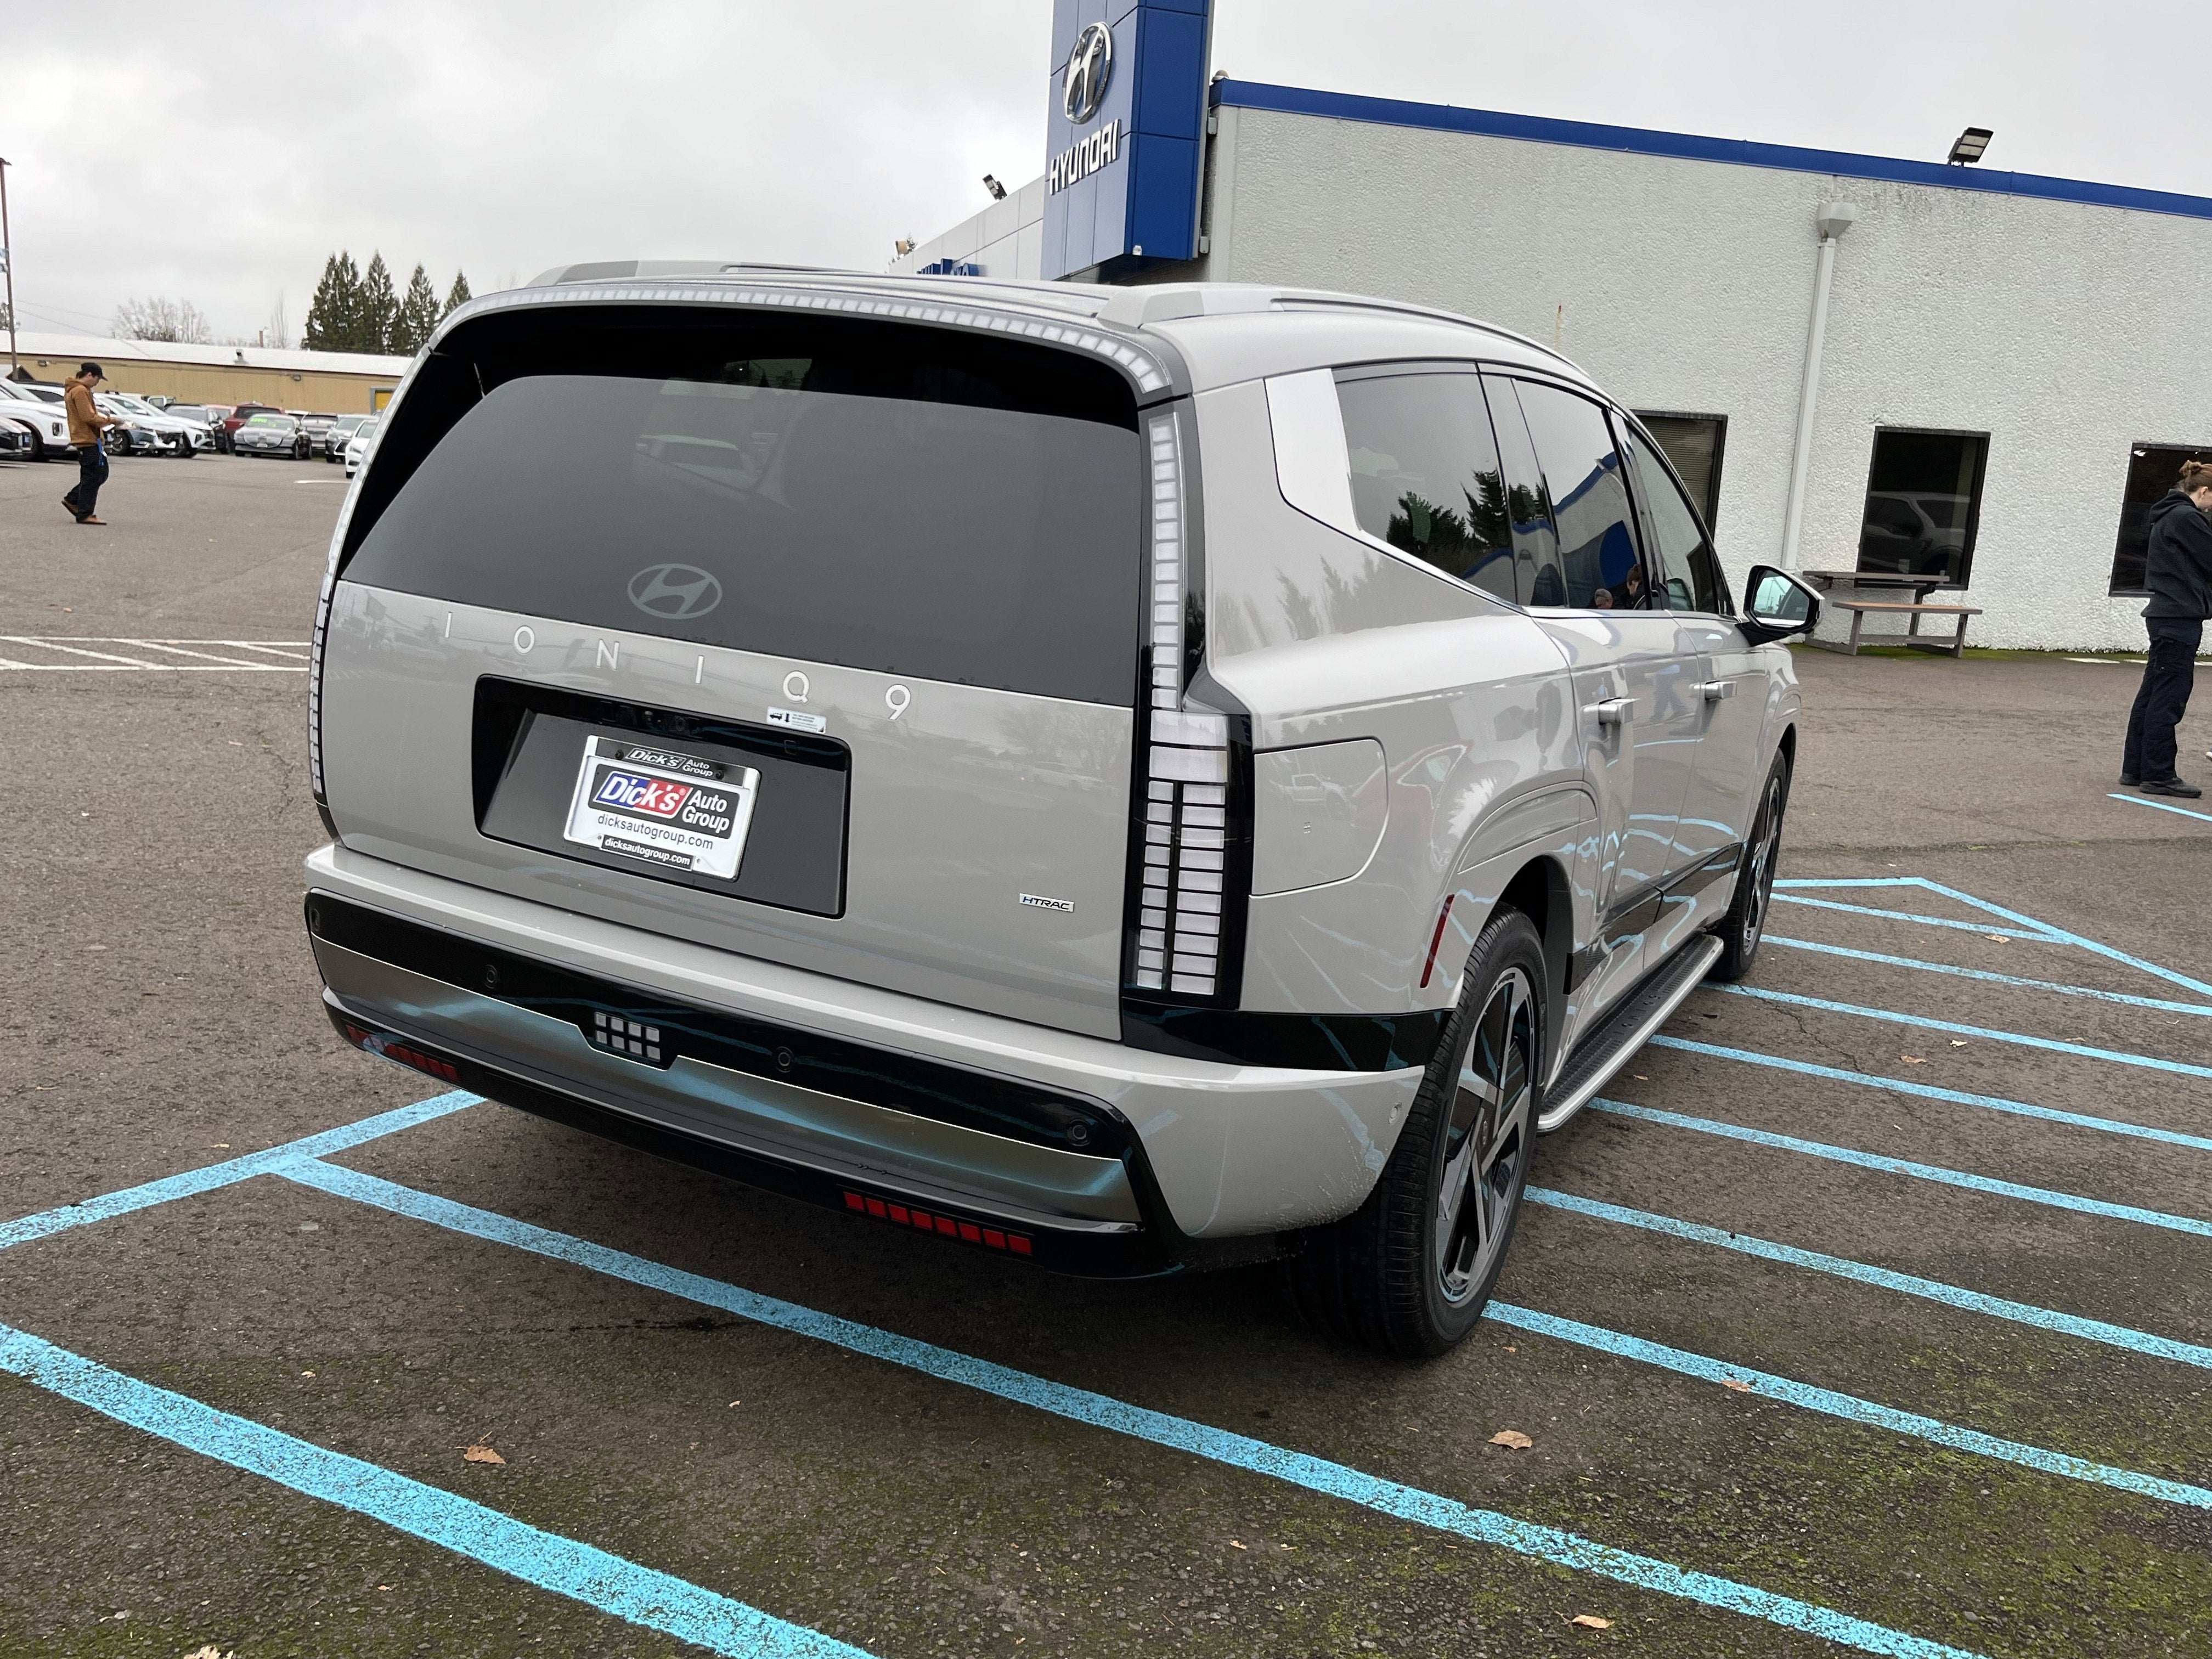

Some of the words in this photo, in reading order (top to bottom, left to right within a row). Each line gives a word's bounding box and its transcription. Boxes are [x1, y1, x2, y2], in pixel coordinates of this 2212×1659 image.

[1049, 118, 1122, 195] HYUNDAI
[444, 611, 810, 704] IONIQ
[884, 684, 911, 721] 9
[630, 749, 680, 767] Dick's
[686, 759, 710, 769] Auto
[682, 765, 713, 777] Group
[601, 776, 681, 812] Dick's
[688, 790, 727, 812] Auto
[597, 814, 714, 850] dicksautogroup.com
[682, 808, 730, 834] Group
[605, 837, 691, 866] dicksautogroup.com
[1023, 896, 1070, 910] HTRAC
